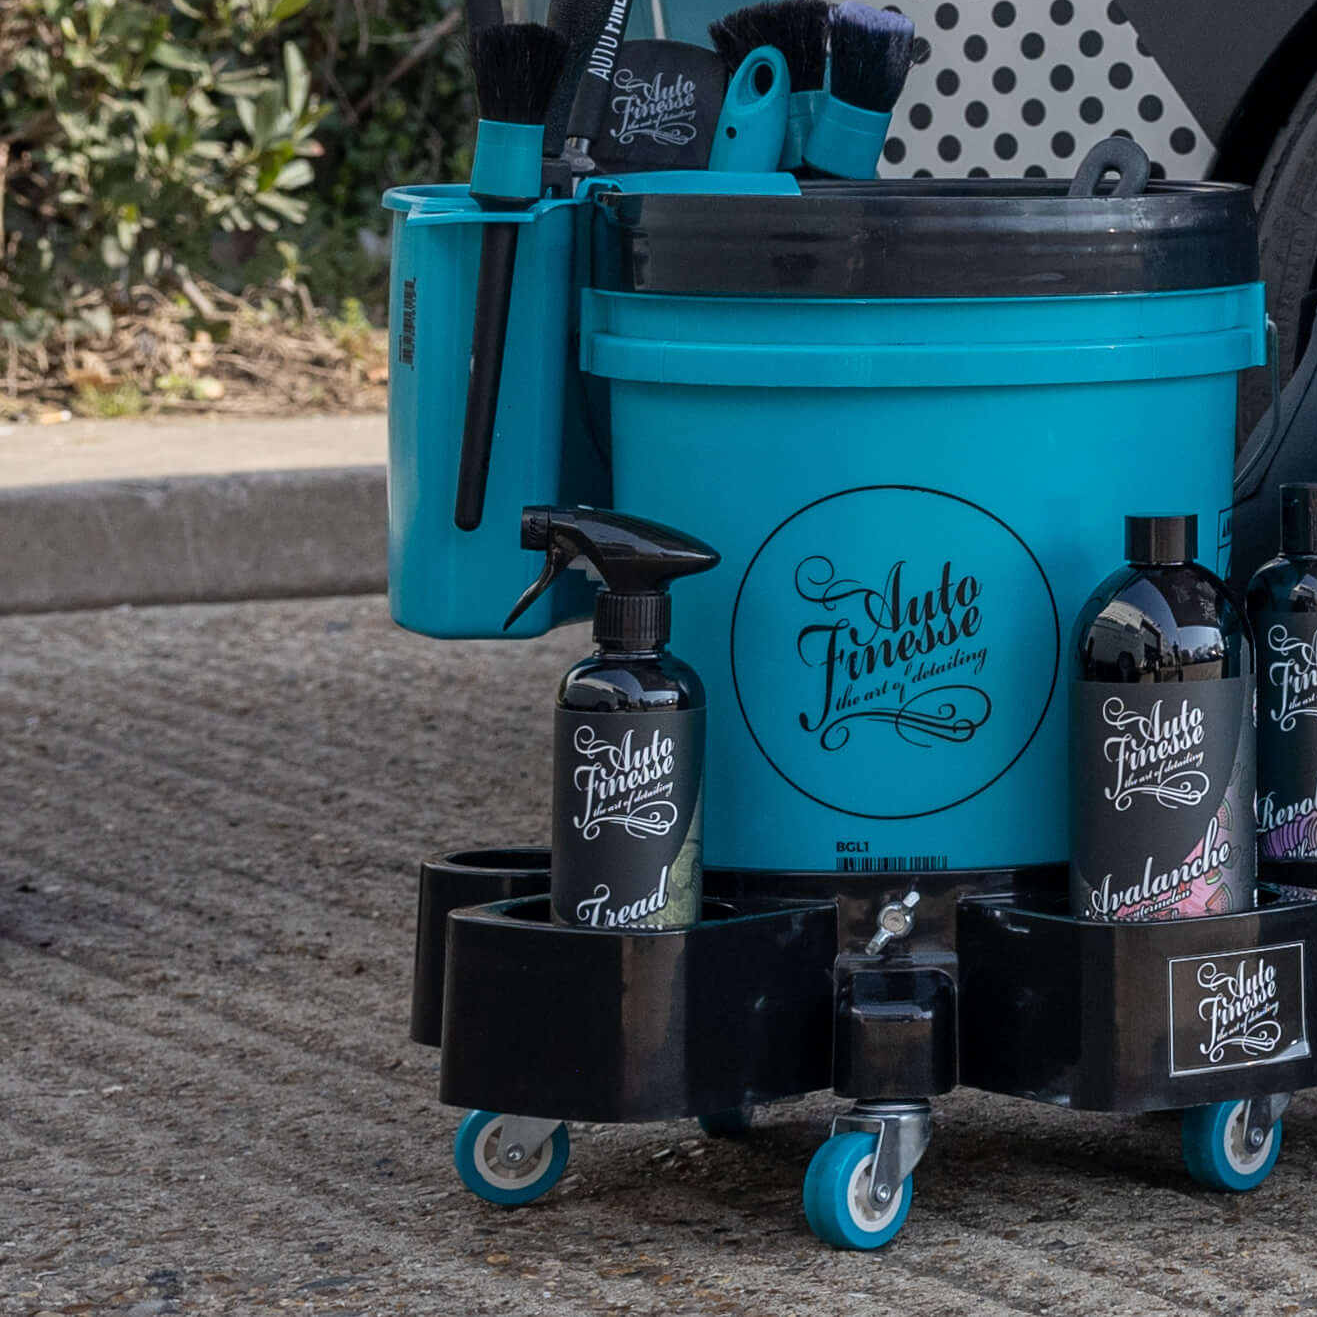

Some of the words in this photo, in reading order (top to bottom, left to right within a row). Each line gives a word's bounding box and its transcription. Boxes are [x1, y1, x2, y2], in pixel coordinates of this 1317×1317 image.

[610, 92, 696, 138] Finesse
[613, 68, 696, 105] Auto
[794, 555, 983, 647] Auto
[797, 605, 983, 732] Finesse
[835, 684, 860, 712] the
[864, 680, 889, 702] art
[892, 662, 913, 704] of
[911, 648, 987, 684] detailing
[574, 725, 674, 779] Auto
[1102, 697, 1204, 751] Auto
[573, 755, 674, 829] Finesse
[1103, 724, 1204, 800] Finesse
[836, 841, 869, 852] BGL1
[1085, 817, 1230, 916] Avalanche
[576, 865, 669, 927] Tread
[1130, 888, 1192, 917] termelon
[1197, 958, 1277, 1007] Auto
[1199, 980, 1277, 1055] Finesse
